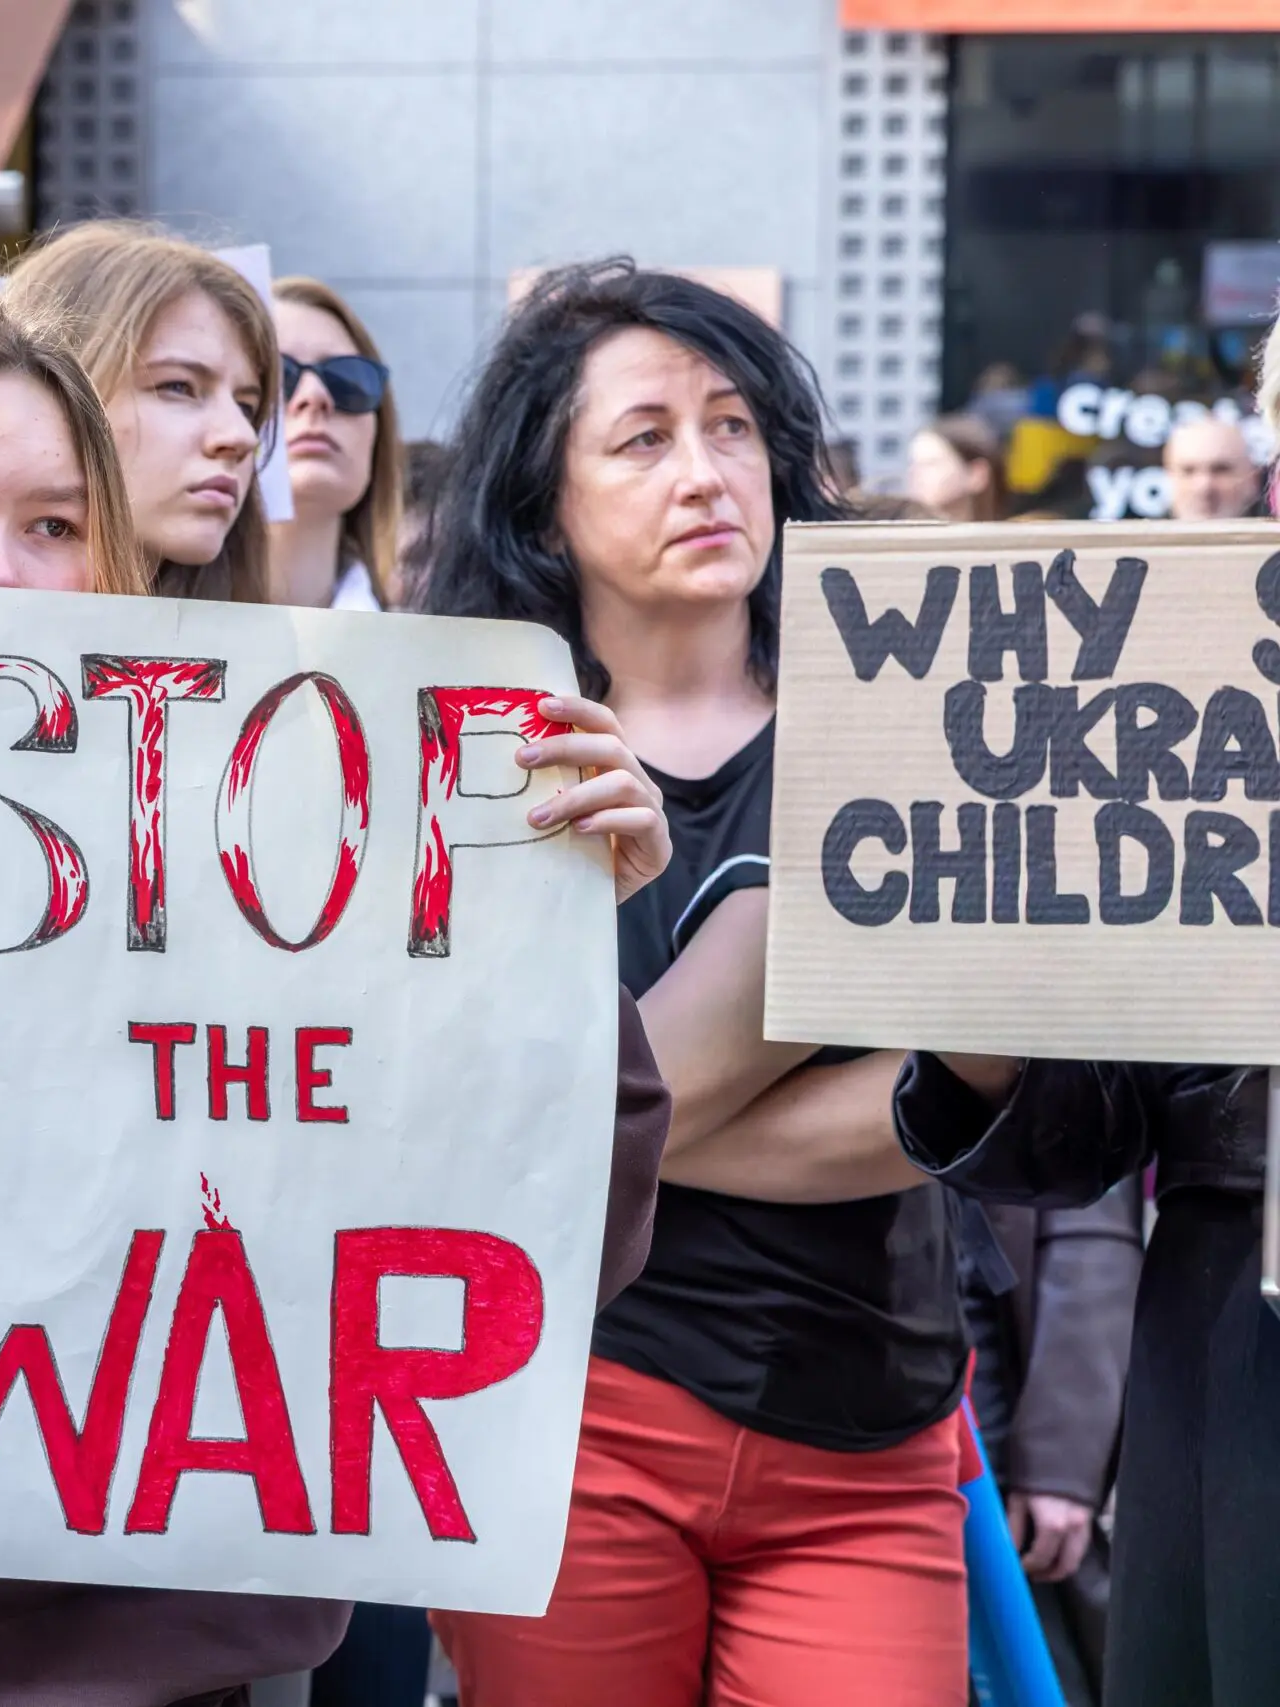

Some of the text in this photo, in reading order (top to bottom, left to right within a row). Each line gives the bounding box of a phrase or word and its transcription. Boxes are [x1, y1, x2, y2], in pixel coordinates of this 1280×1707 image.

[820, 549, 1149, 682] WHY
[944, 681, 1280, 801] UKRA
[127, 1021, 354, 1123] THE
